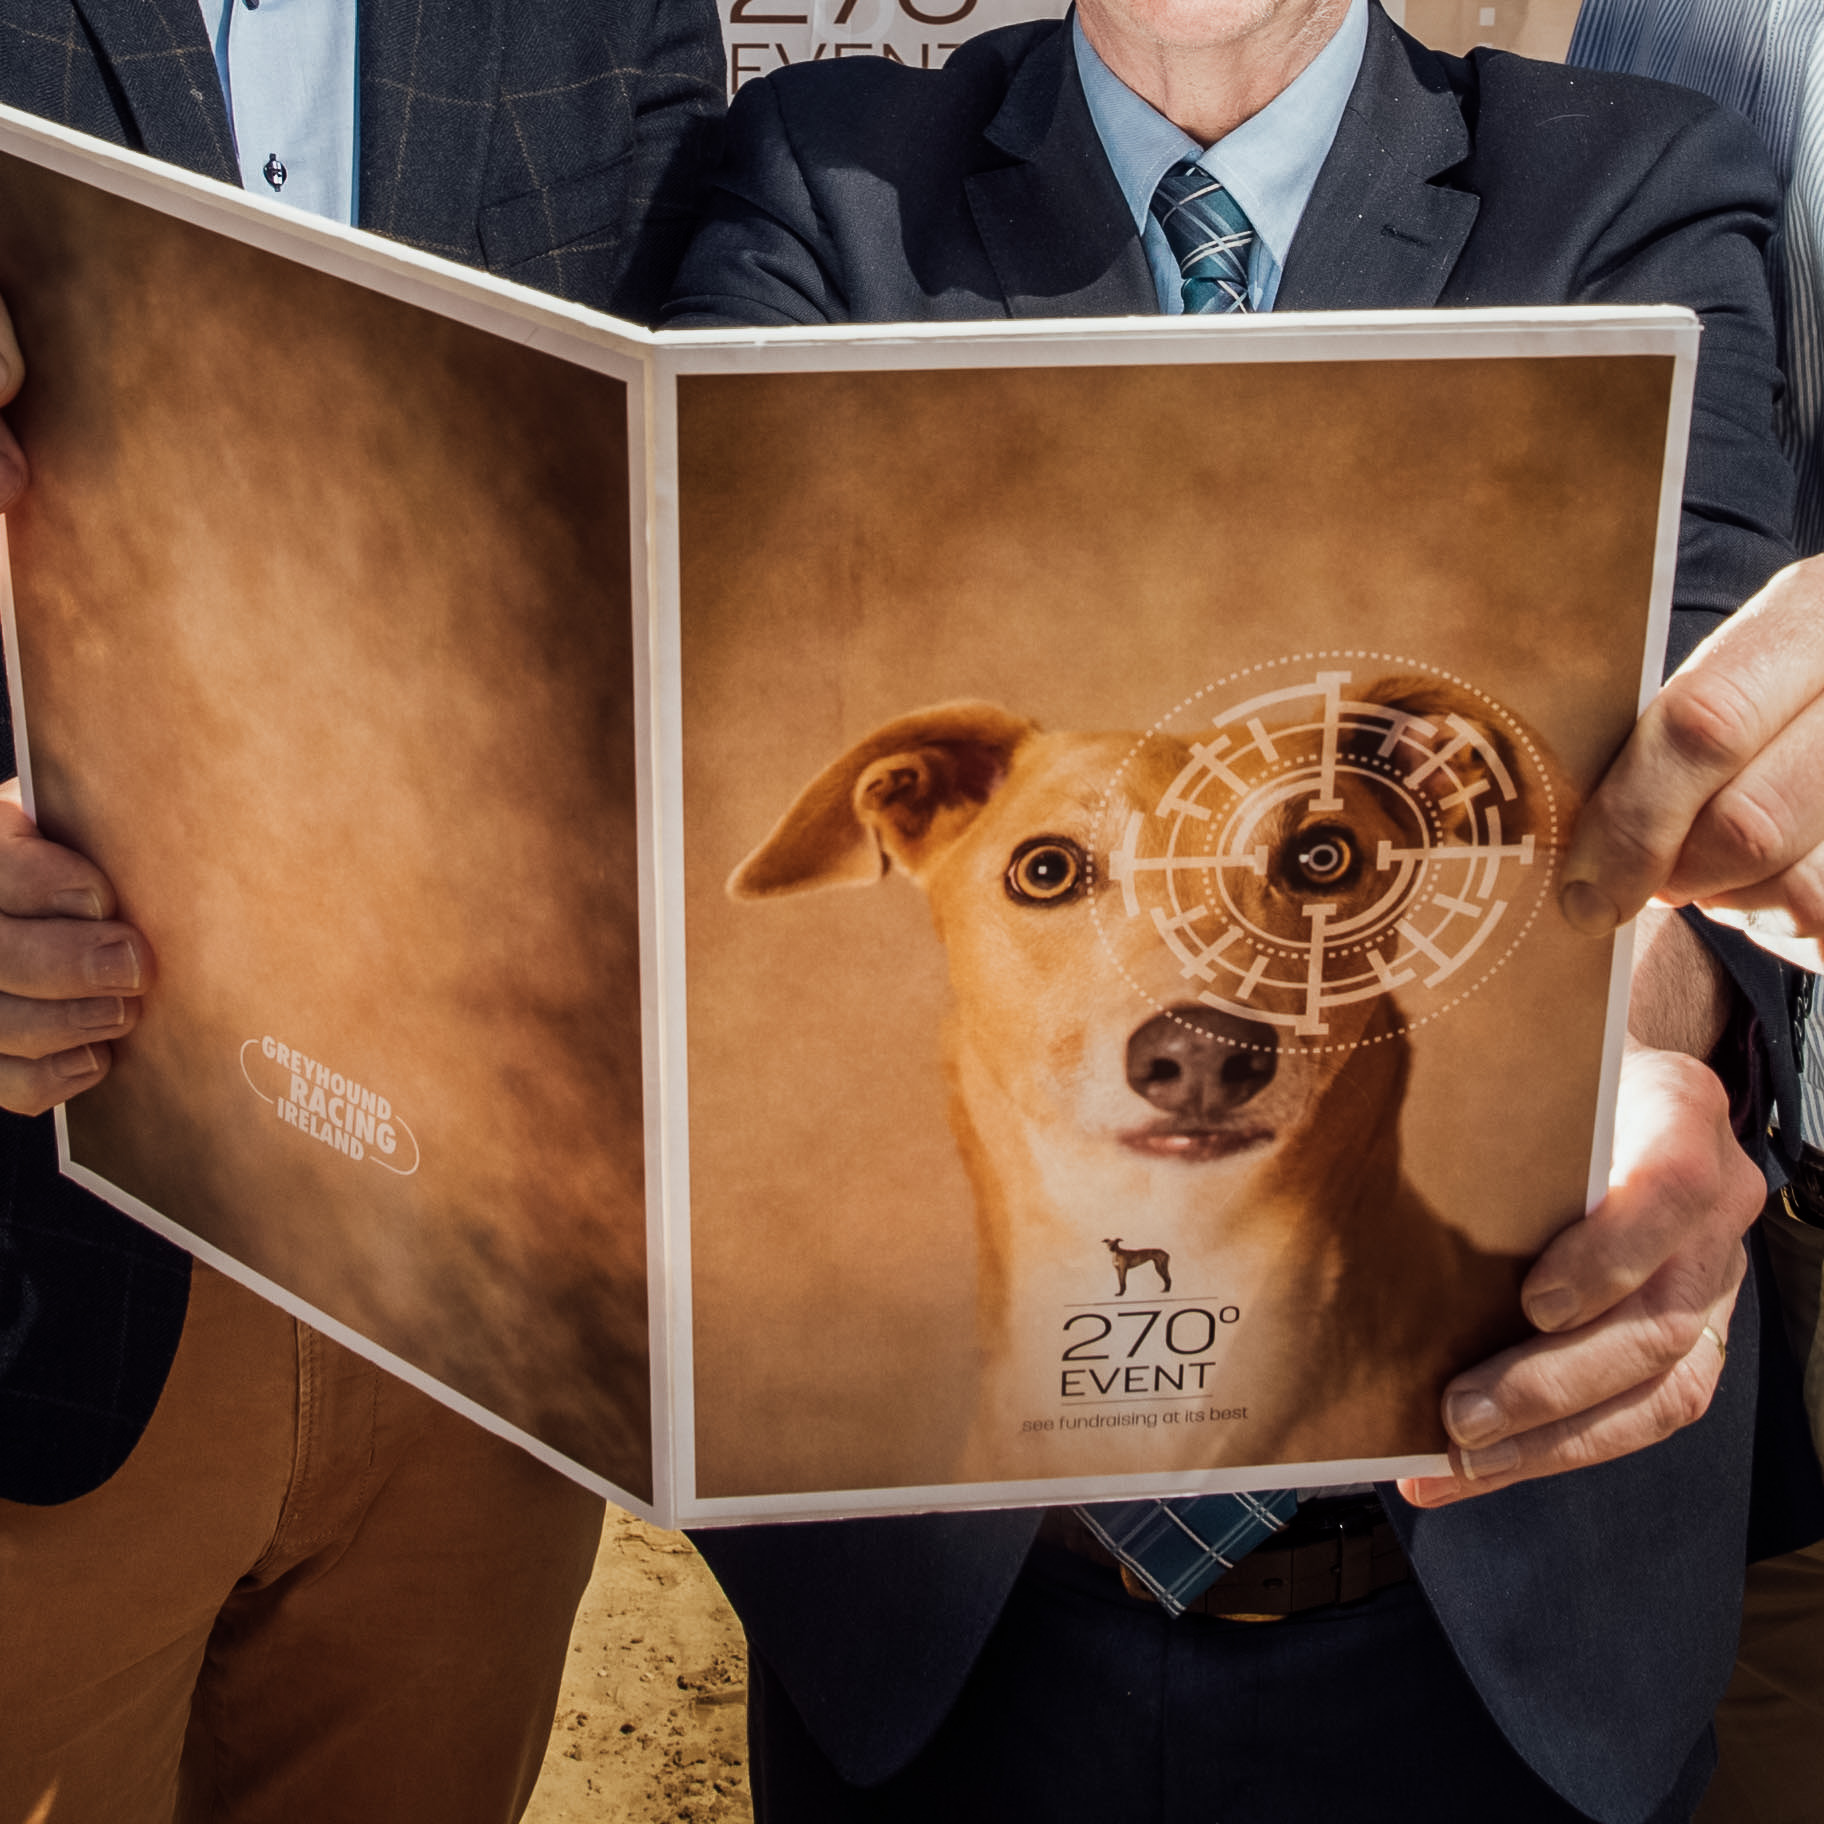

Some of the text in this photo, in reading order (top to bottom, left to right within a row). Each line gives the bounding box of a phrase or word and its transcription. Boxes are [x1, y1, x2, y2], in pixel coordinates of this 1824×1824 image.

[261, 1035, 393, 1122] GREYHOUND
[276, 1096, 366, 1162] IRELAND
[289, 1073, 398, 1155] RACING
[1061, 1361, 1217, 1398] EVENT
[1022, 1406, 1249, 1433] see fundraising at its best
